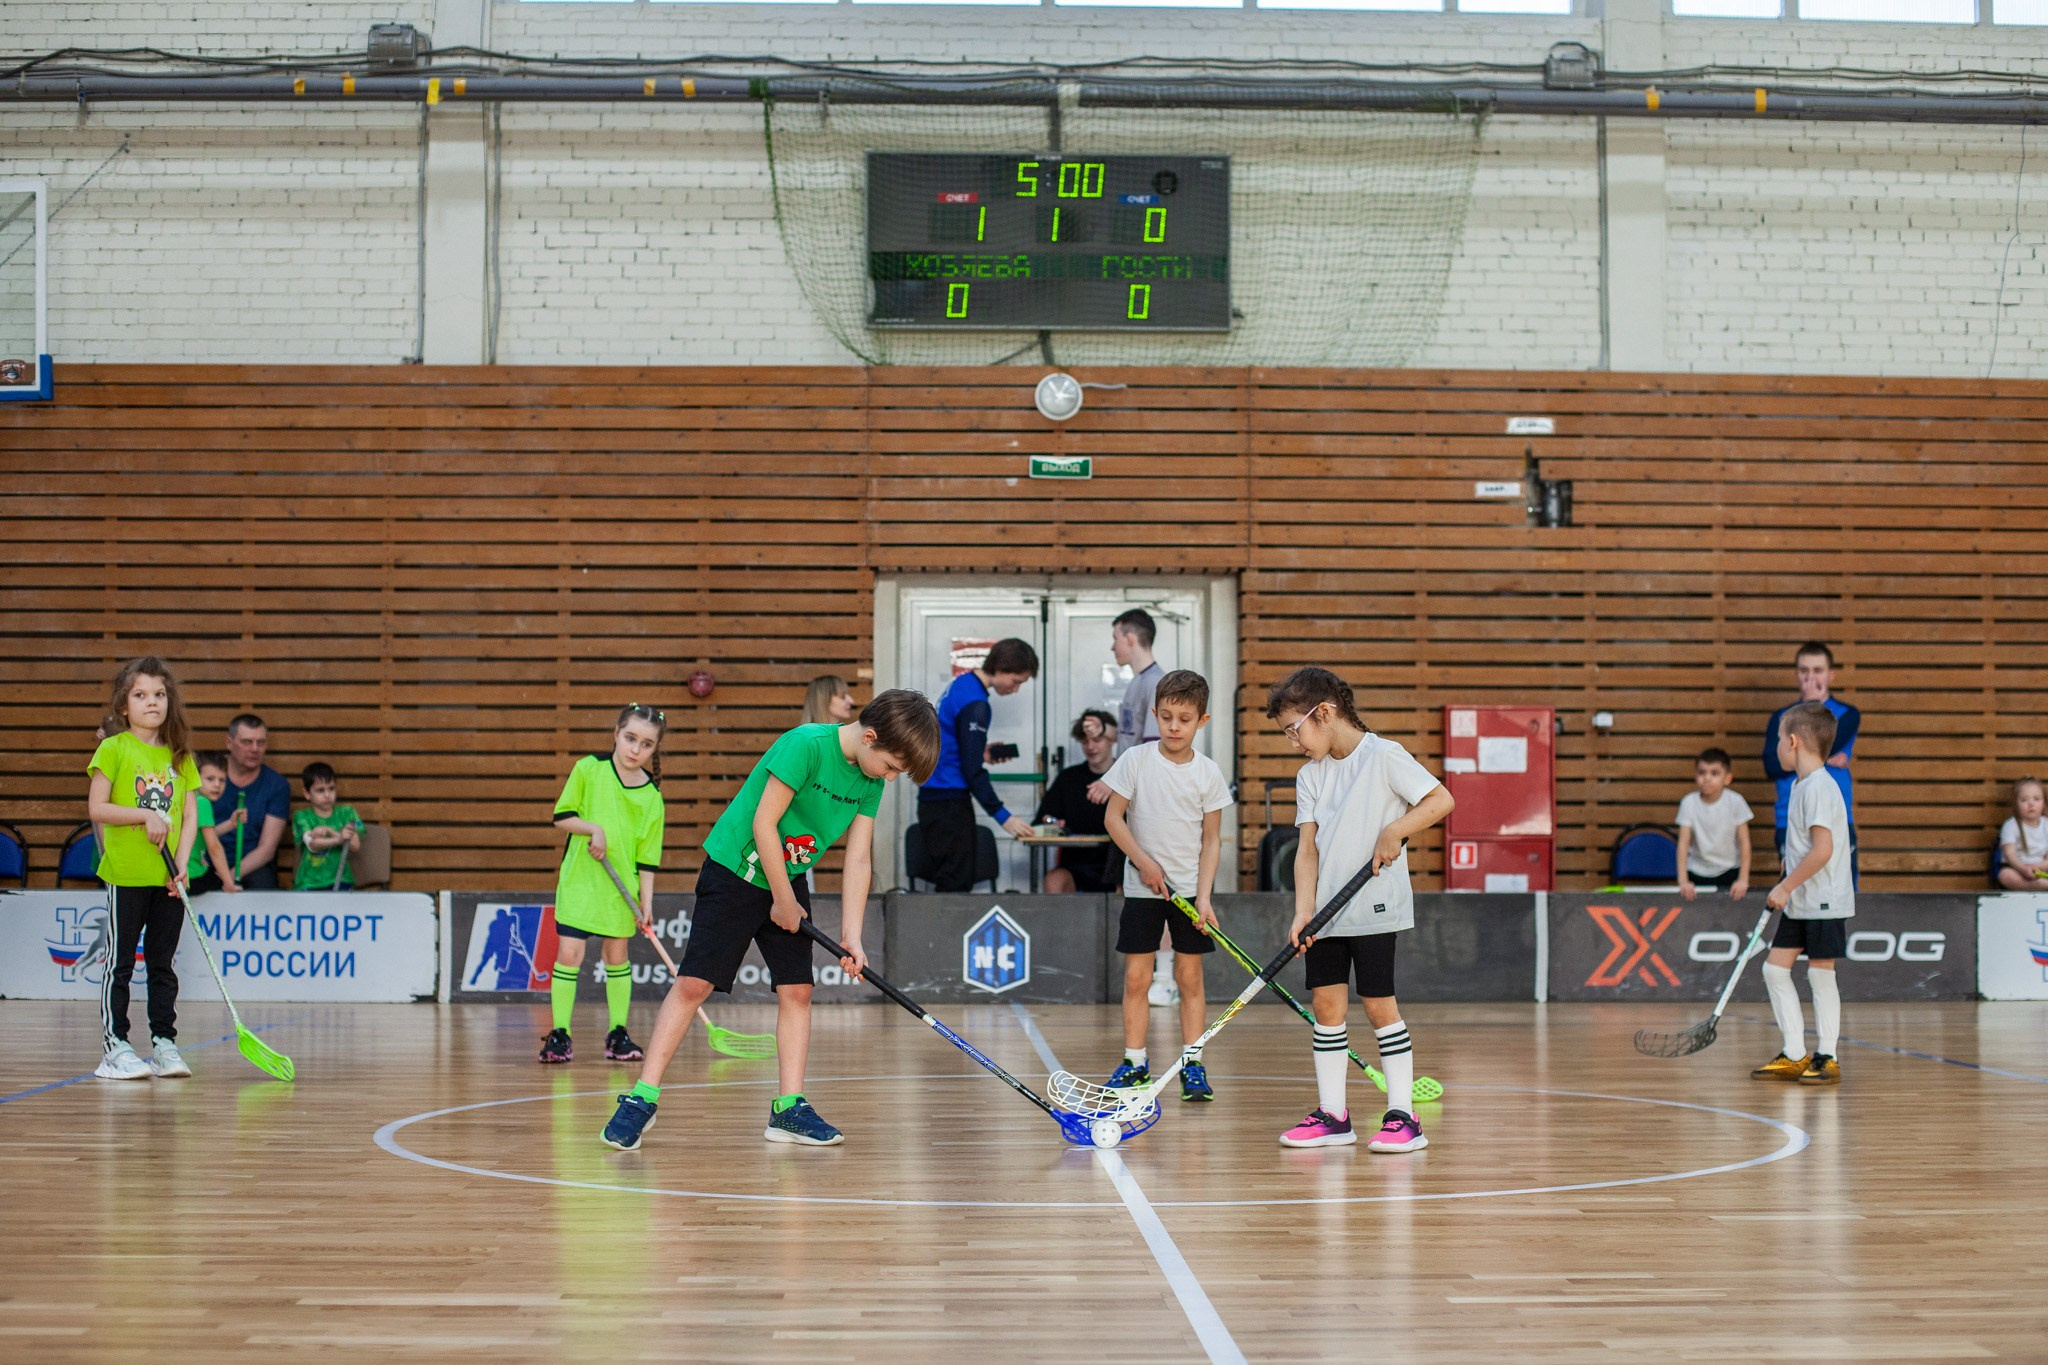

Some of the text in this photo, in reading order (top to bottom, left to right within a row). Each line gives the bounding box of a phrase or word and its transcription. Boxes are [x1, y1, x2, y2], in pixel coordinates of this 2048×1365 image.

[977, 206, 986, 242] 1
[1051, 207, 1060, 242] 1
[1143, 207, 1167, 243] 0
[1103, 256, 1191, 279] ГОСТИ
[946, 283, 970, 318] 0
[1127, 284, 1151, 319] 0
[198, 914, 383, 941] МИНСПОРТ
[1688, 931, 1946, 961] OOG
[222, 951, 355, 978] РОССИИ
